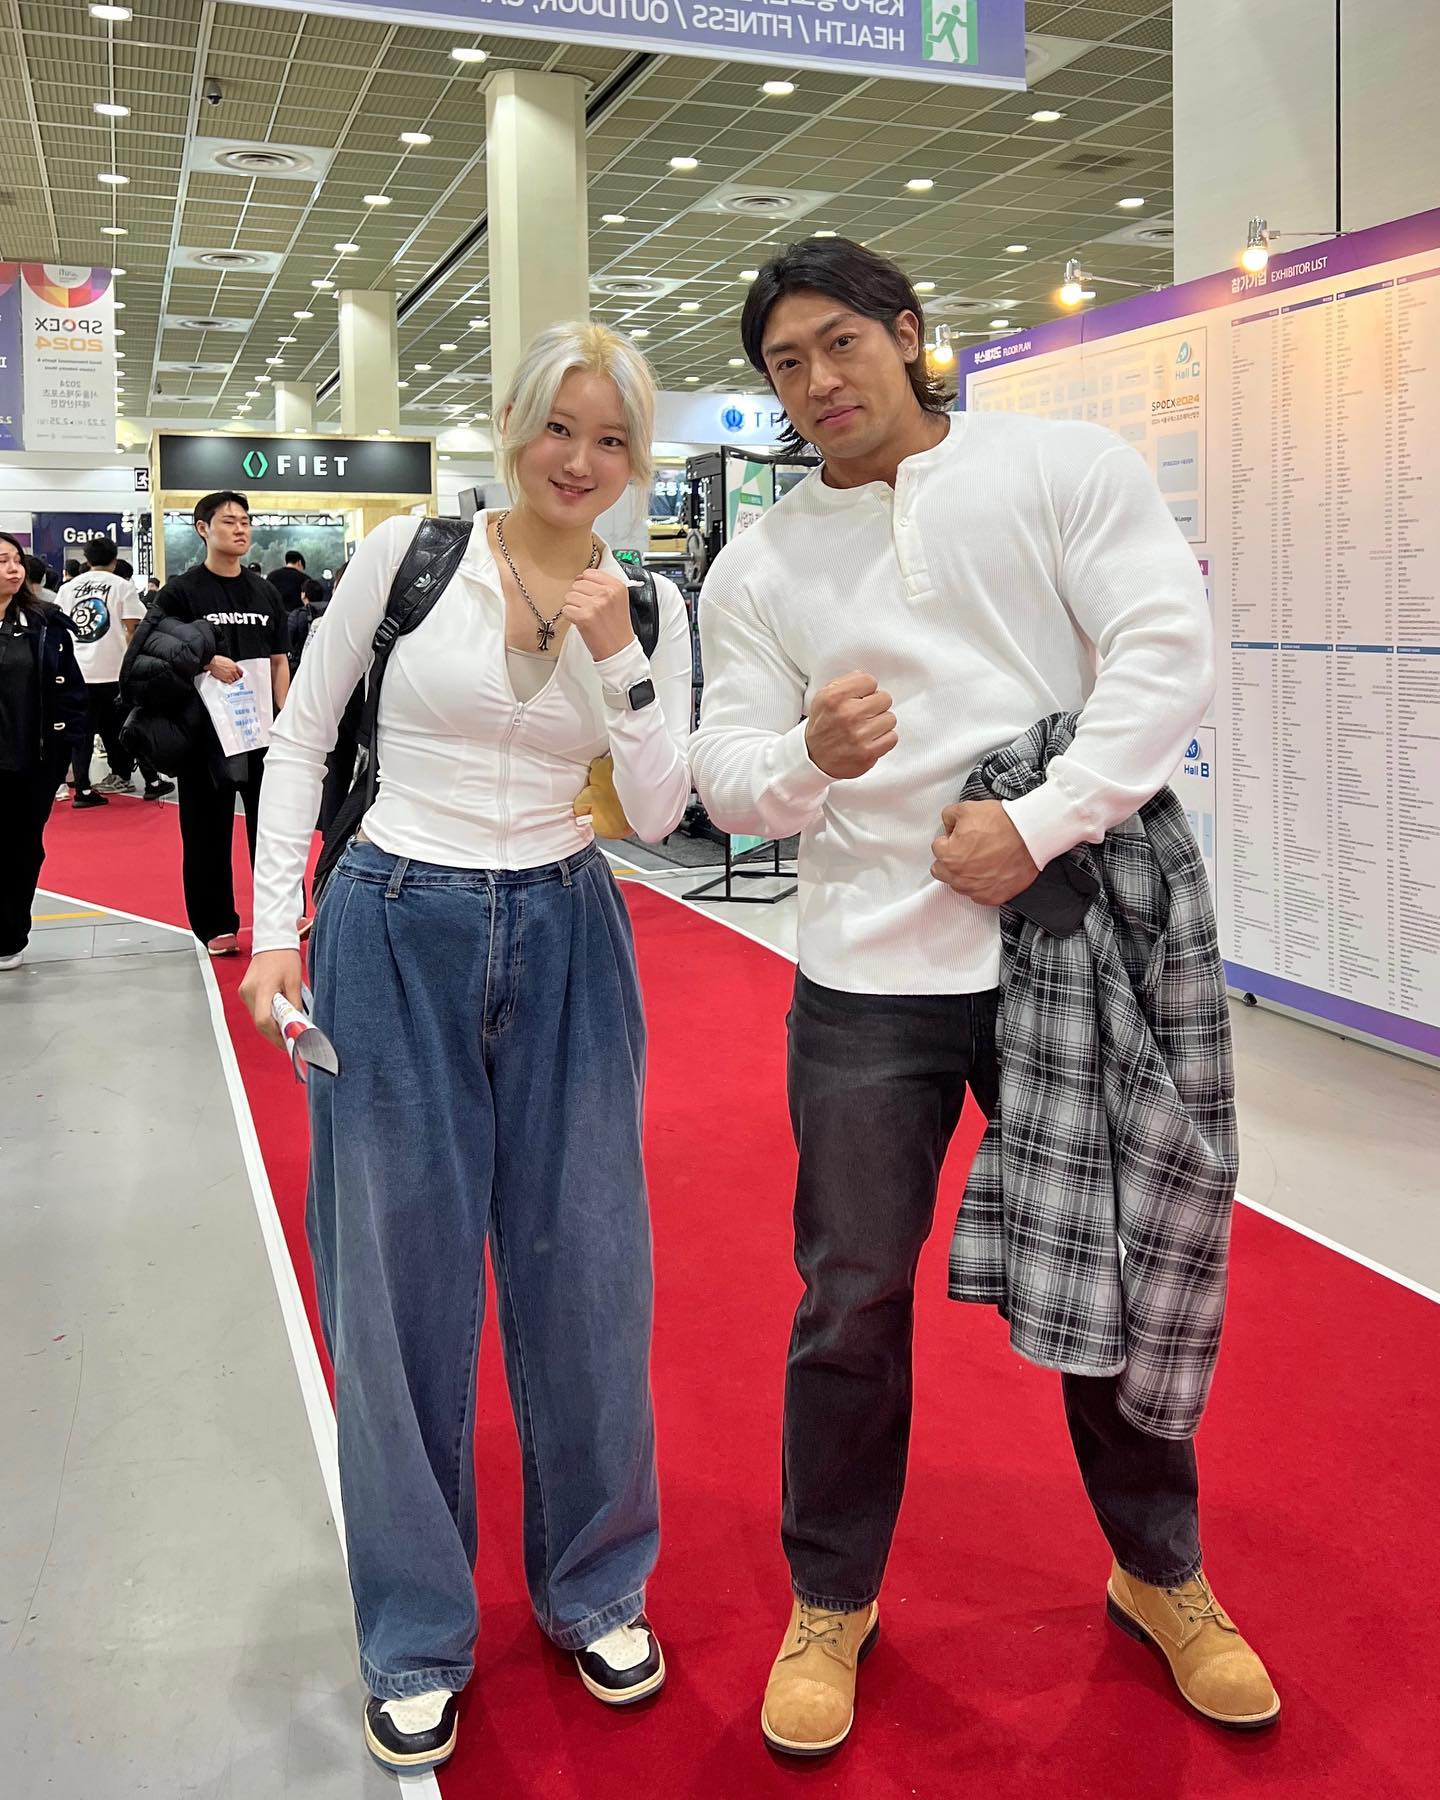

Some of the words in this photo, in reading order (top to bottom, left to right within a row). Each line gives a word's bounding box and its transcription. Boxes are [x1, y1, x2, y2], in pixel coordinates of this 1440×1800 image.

[1271, 260, 1310, 282] EXHIBITOR
[1311, 256, 1328, 271] LIST
[276, 454, 349, 476] FIET
[64, 527, 105, 543] Gate
[106, 523, 118, 543] 1
[206, 612, 269, 626] SINCITY
[1184, 764, 1199, 776] Hall
[1200, 762, 1209, 777] B
